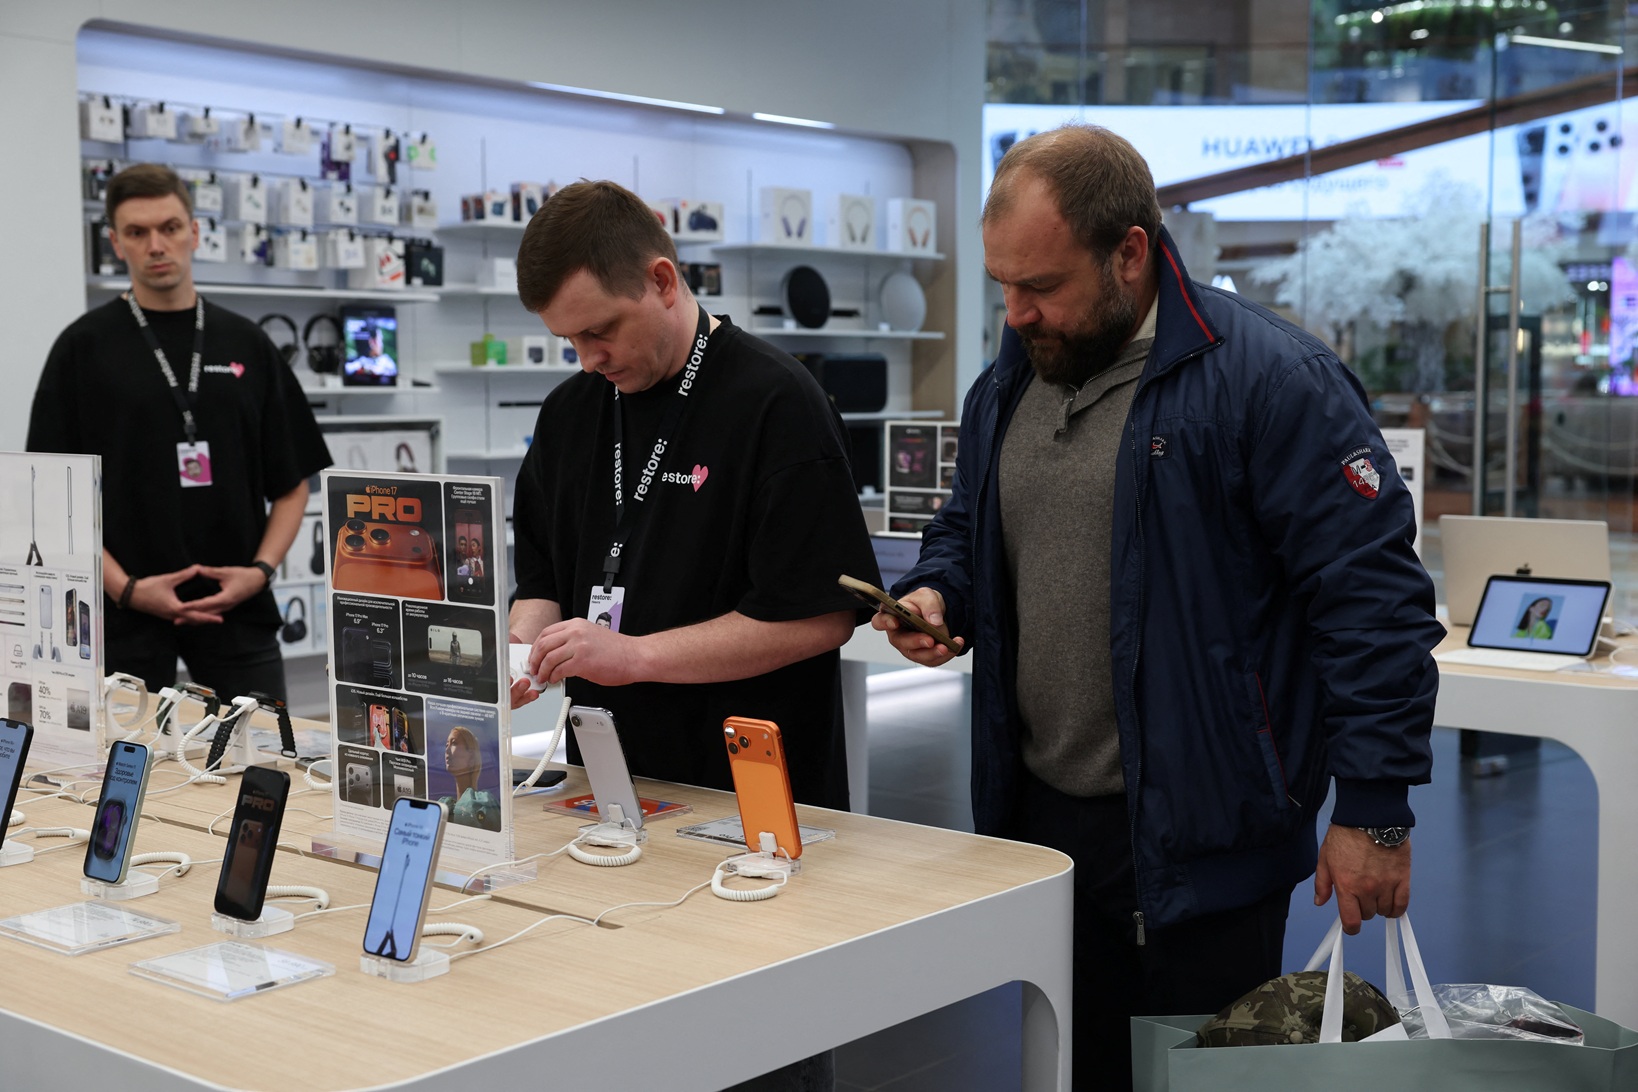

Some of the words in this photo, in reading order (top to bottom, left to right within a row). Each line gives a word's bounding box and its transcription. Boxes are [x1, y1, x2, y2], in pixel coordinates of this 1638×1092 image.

[678, 333, 708, 396] restore:
[614, 442, 623, 506] restore:
[633, 438, 668, 501] restore:
[662, 471, 701, 484] estore:
[371, 485, 391, 495] iPhone
[391, 486, 397, 495] 17
[346, 494, 422, 522] PRO
[241, 794, 275, 812] PRO
[394, 827, 412, 837] Самый
[412, 832, 430, 840] тонкий
[402, 837, 419, 847] iPhone
